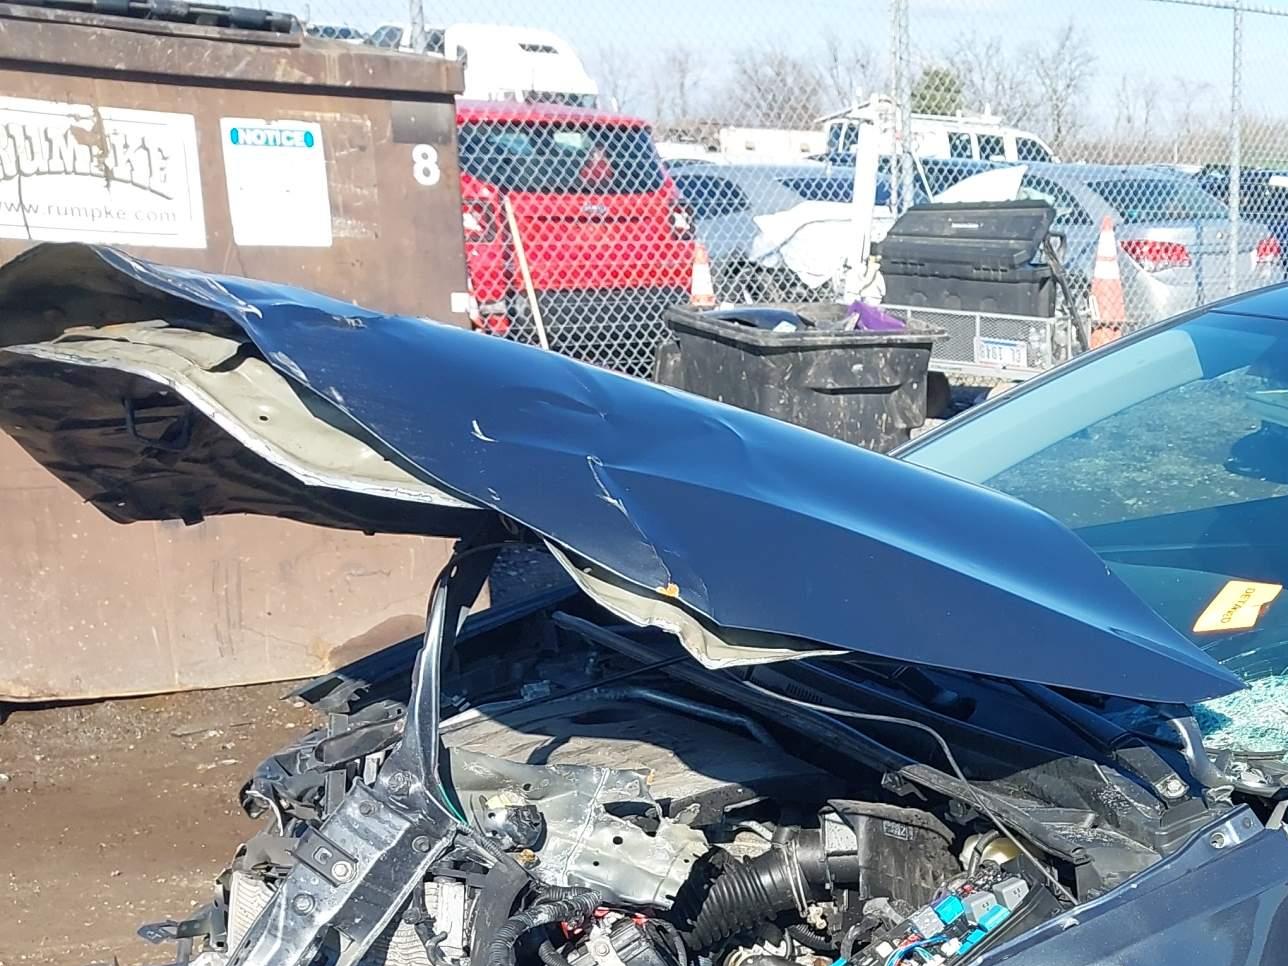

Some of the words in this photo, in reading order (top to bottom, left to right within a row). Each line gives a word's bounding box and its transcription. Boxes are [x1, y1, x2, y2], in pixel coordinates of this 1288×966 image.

[238, 128, 305, 147] NOTICE
[0, 122, 172, 199] RUMKE
[412, 144, 441, 186] 8
